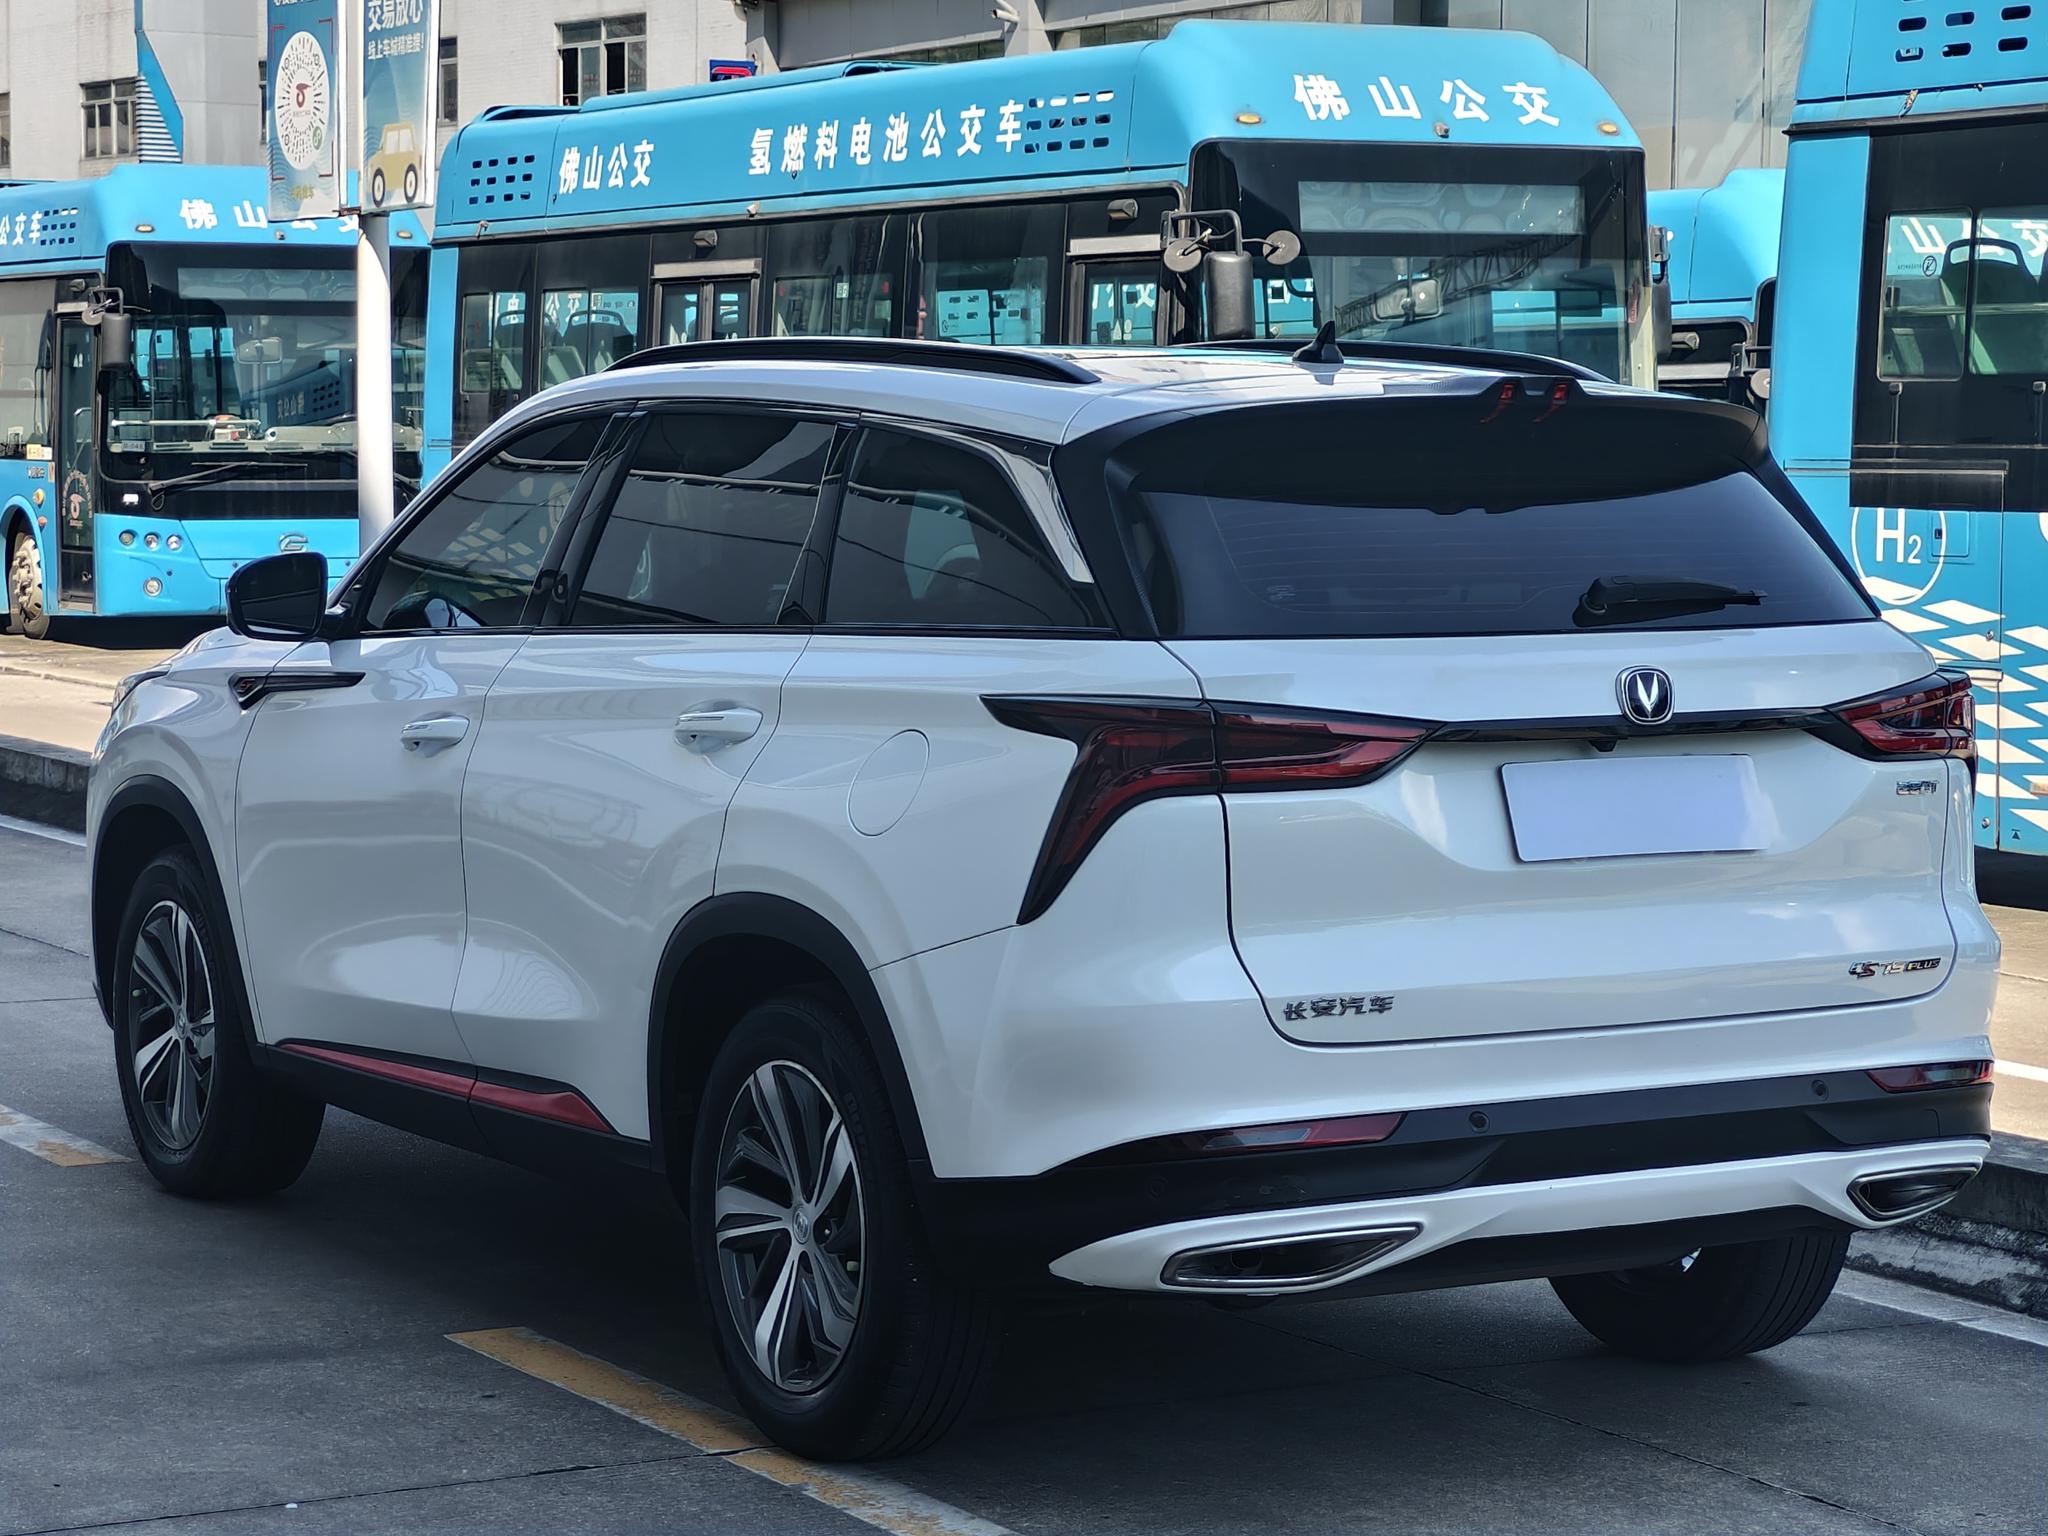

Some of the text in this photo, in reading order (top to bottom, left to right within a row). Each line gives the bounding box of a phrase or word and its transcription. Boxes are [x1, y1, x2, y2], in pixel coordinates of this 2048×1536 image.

[1293, 73, 1560, 127] 佛山公交
[748, 98, 1025, 177] 氢燃料电池公交车
[559, 139, 655, 195] 佛山公交
[1906, 957, 1941, 972] PLUS
[1283, 995, 1395, 1021] 长安汽车
